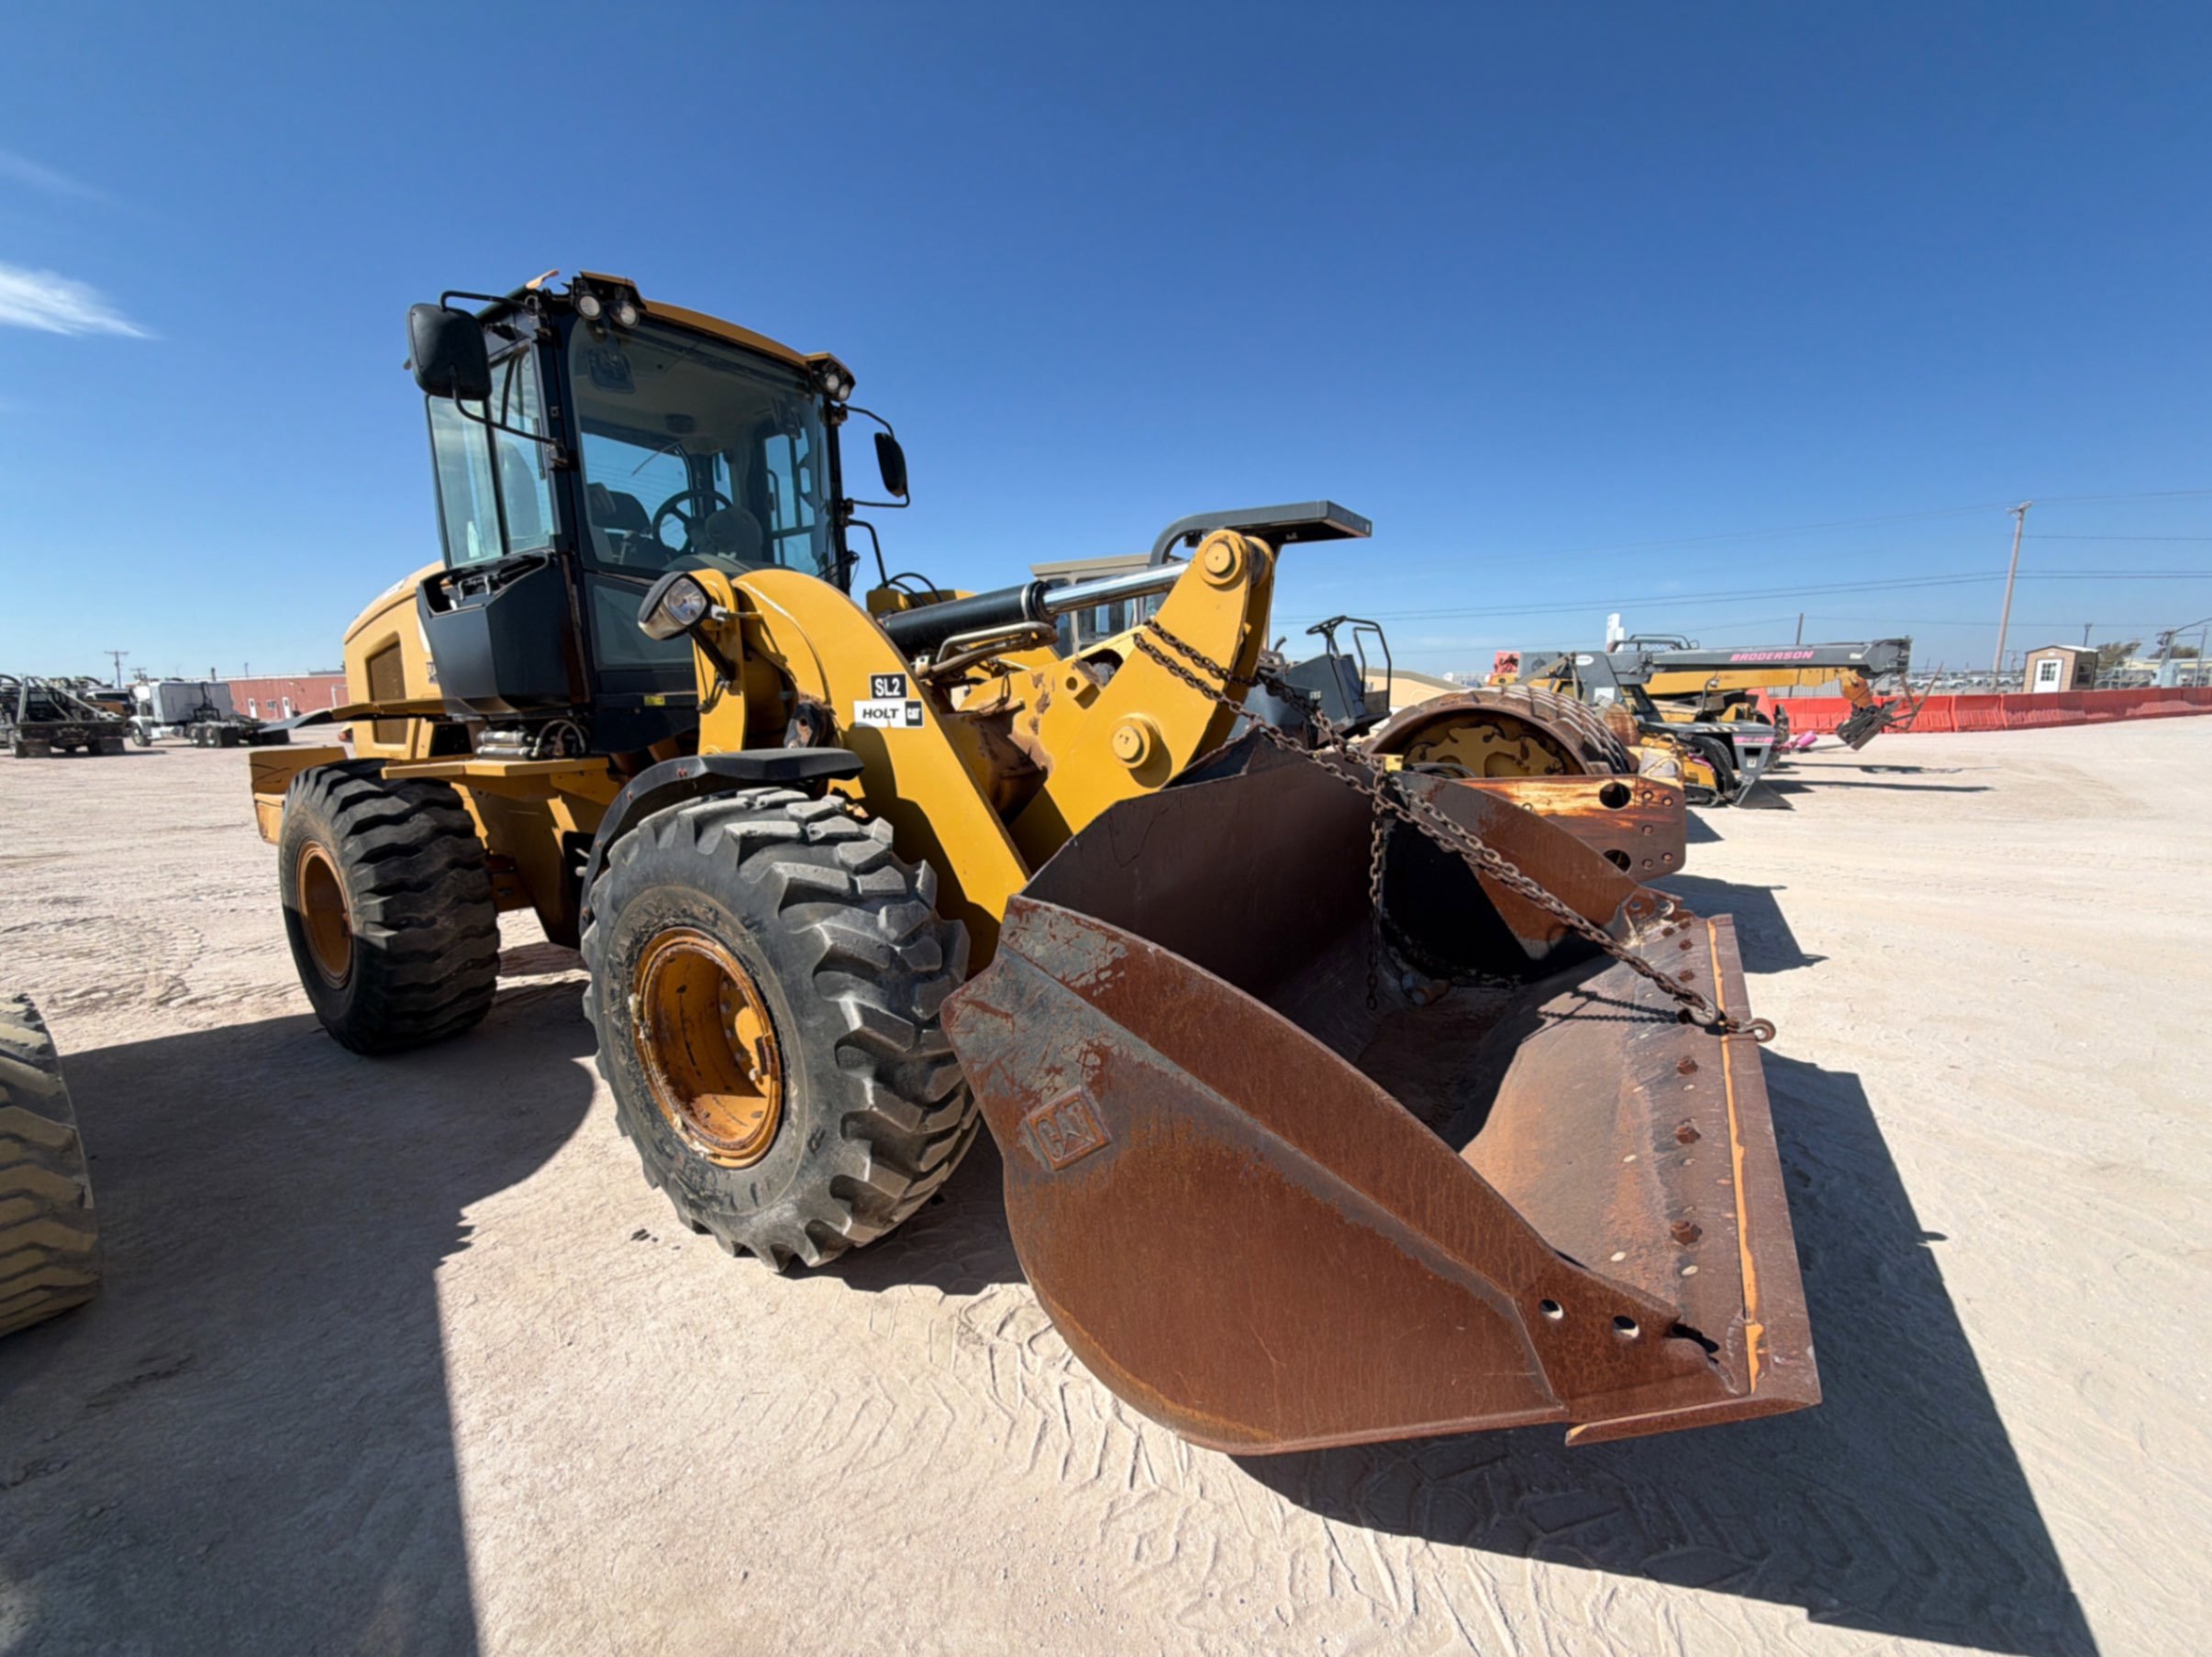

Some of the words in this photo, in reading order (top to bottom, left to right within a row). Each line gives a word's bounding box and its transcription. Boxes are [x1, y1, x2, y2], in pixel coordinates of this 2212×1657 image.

[1729, 651, 1814, 662] BRODERSON
[874, 677, 901, 696] SL2
[862, 708, 899, 718] HOLT
[1037, 1100, 1096, 1162] CAT
